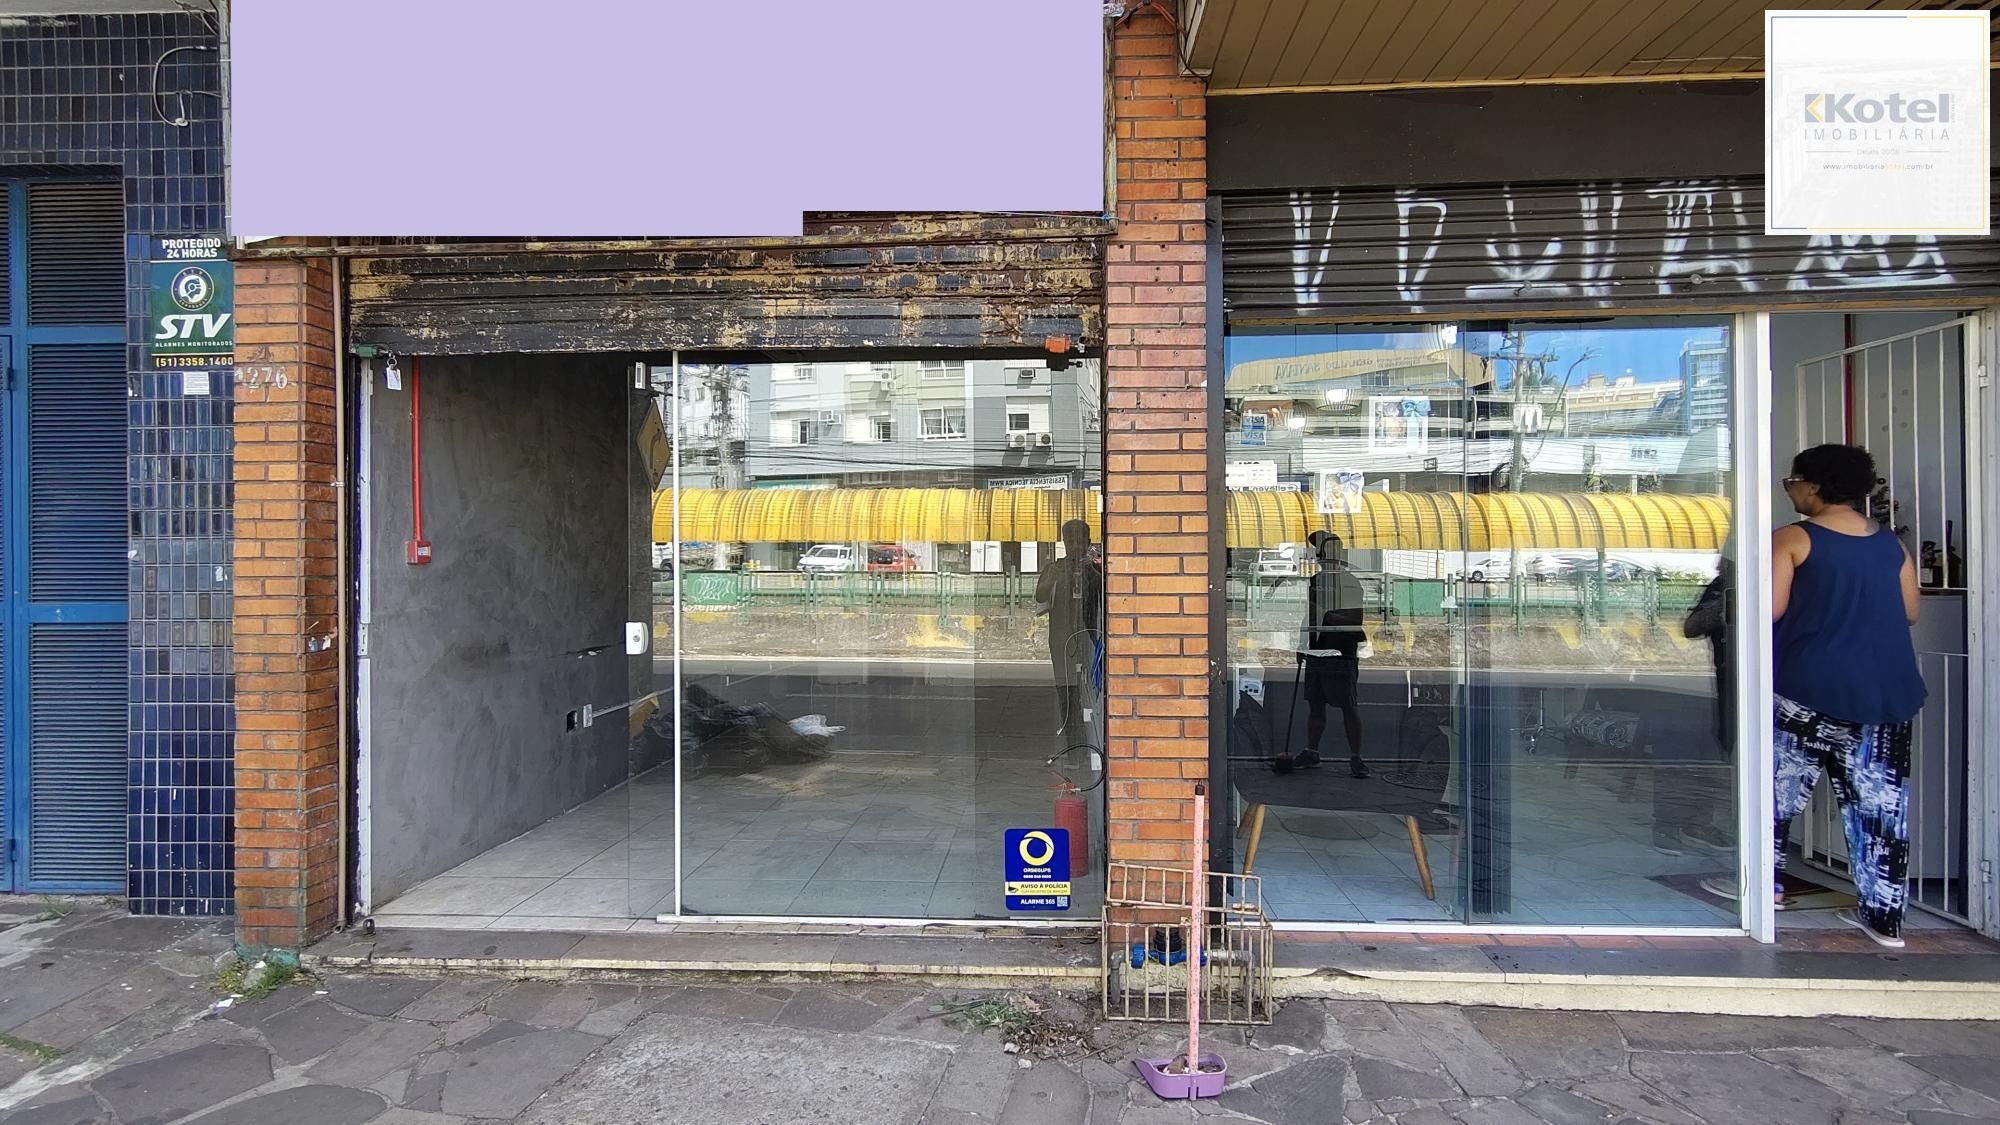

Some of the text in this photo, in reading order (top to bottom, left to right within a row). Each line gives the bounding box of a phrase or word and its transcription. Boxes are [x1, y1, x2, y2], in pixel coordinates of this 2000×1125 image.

[162, 238, 221, 249] PROTEGIDO
[166, 248, 218, 259] 24 HORAS
[155, 313, 232, 340] STV
